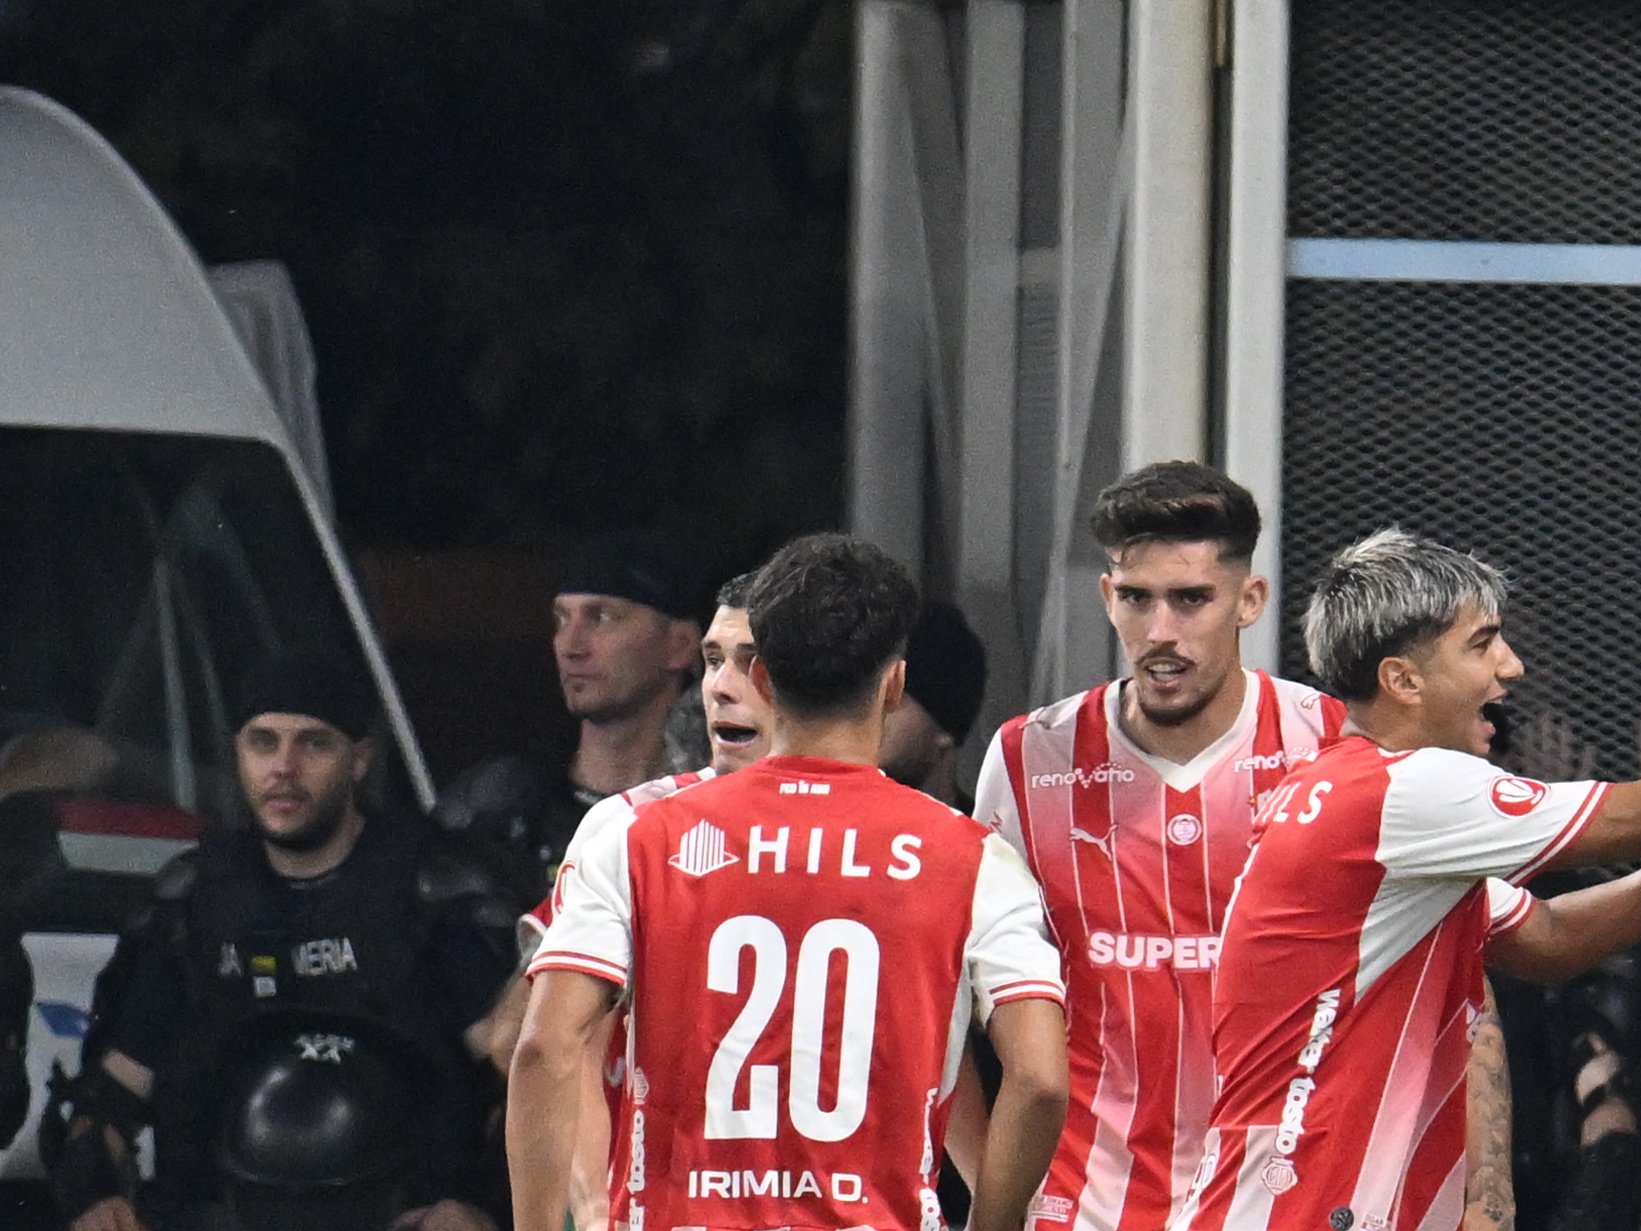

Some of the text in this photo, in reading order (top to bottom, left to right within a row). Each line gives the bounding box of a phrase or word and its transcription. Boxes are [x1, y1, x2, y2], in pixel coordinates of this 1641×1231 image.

[746, 826, 922, 880] HILS
[704, 914, 880, 1143] 20
[688, 1170, 868, 1203] IRIMIA D.
